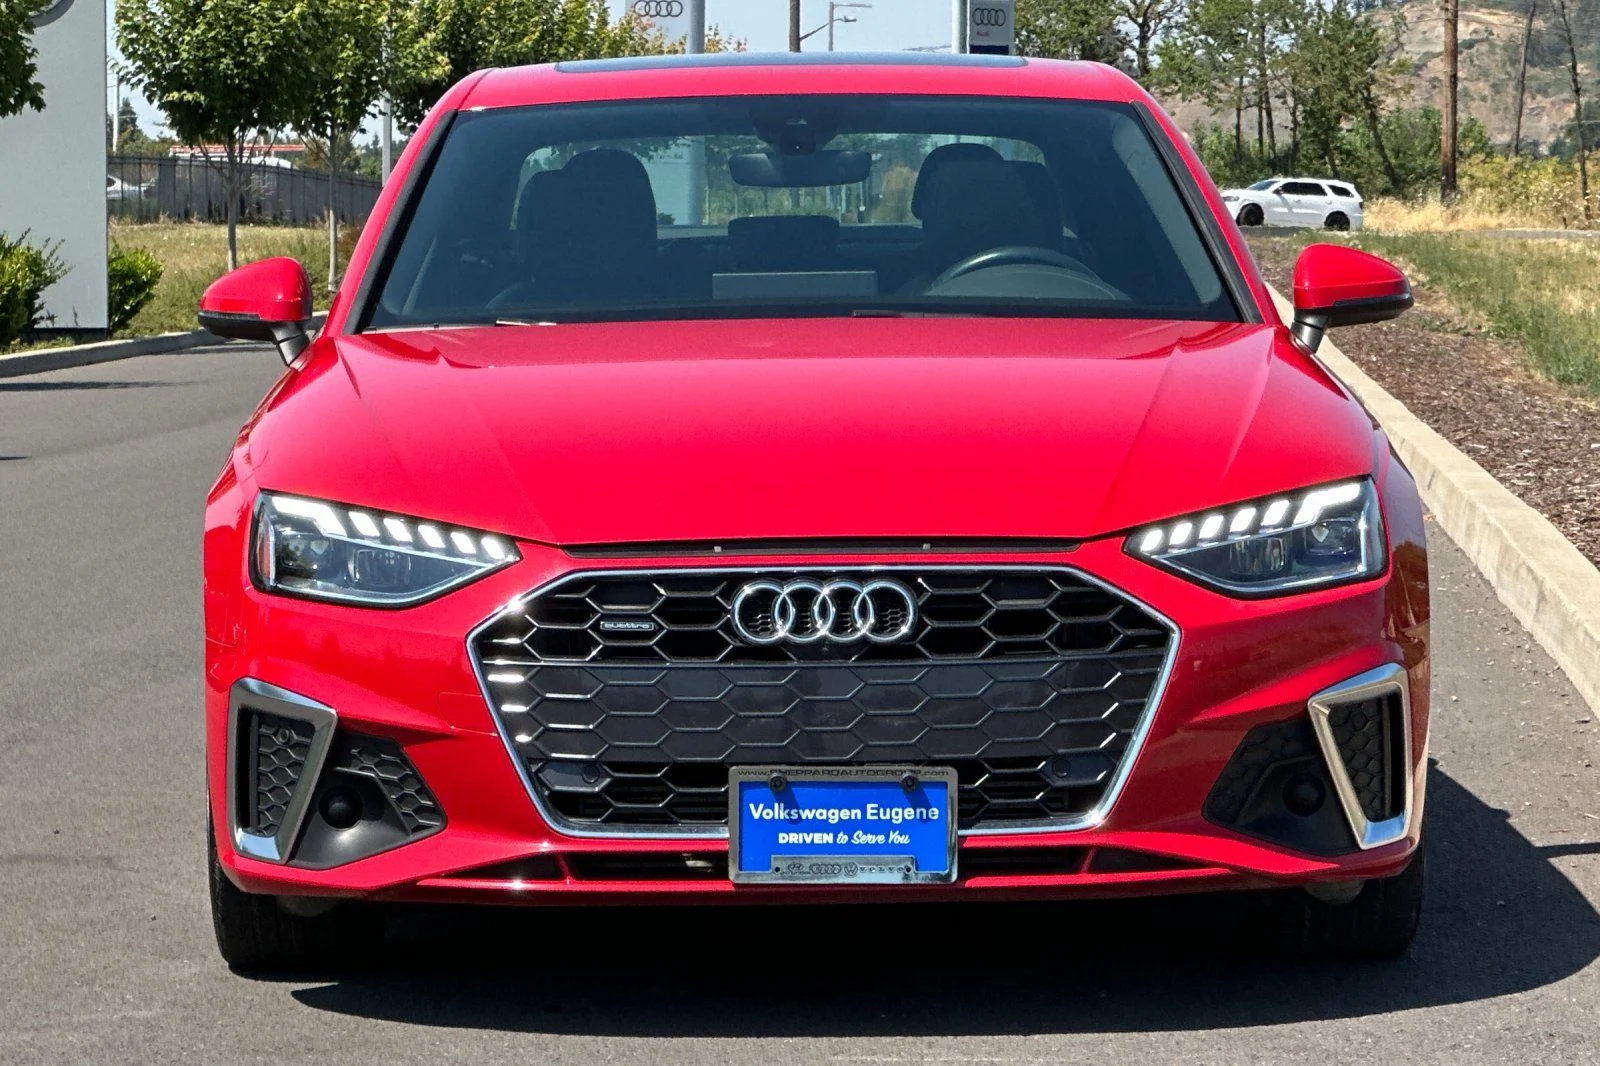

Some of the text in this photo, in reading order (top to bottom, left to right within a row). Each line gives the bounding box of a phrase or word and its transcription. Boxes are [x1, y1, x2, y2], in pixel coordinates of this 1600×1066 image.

[749, 803, 939, 824] Volkswagen Eugene
[778, 830, 911, 845] DRIVEN to Serve You
